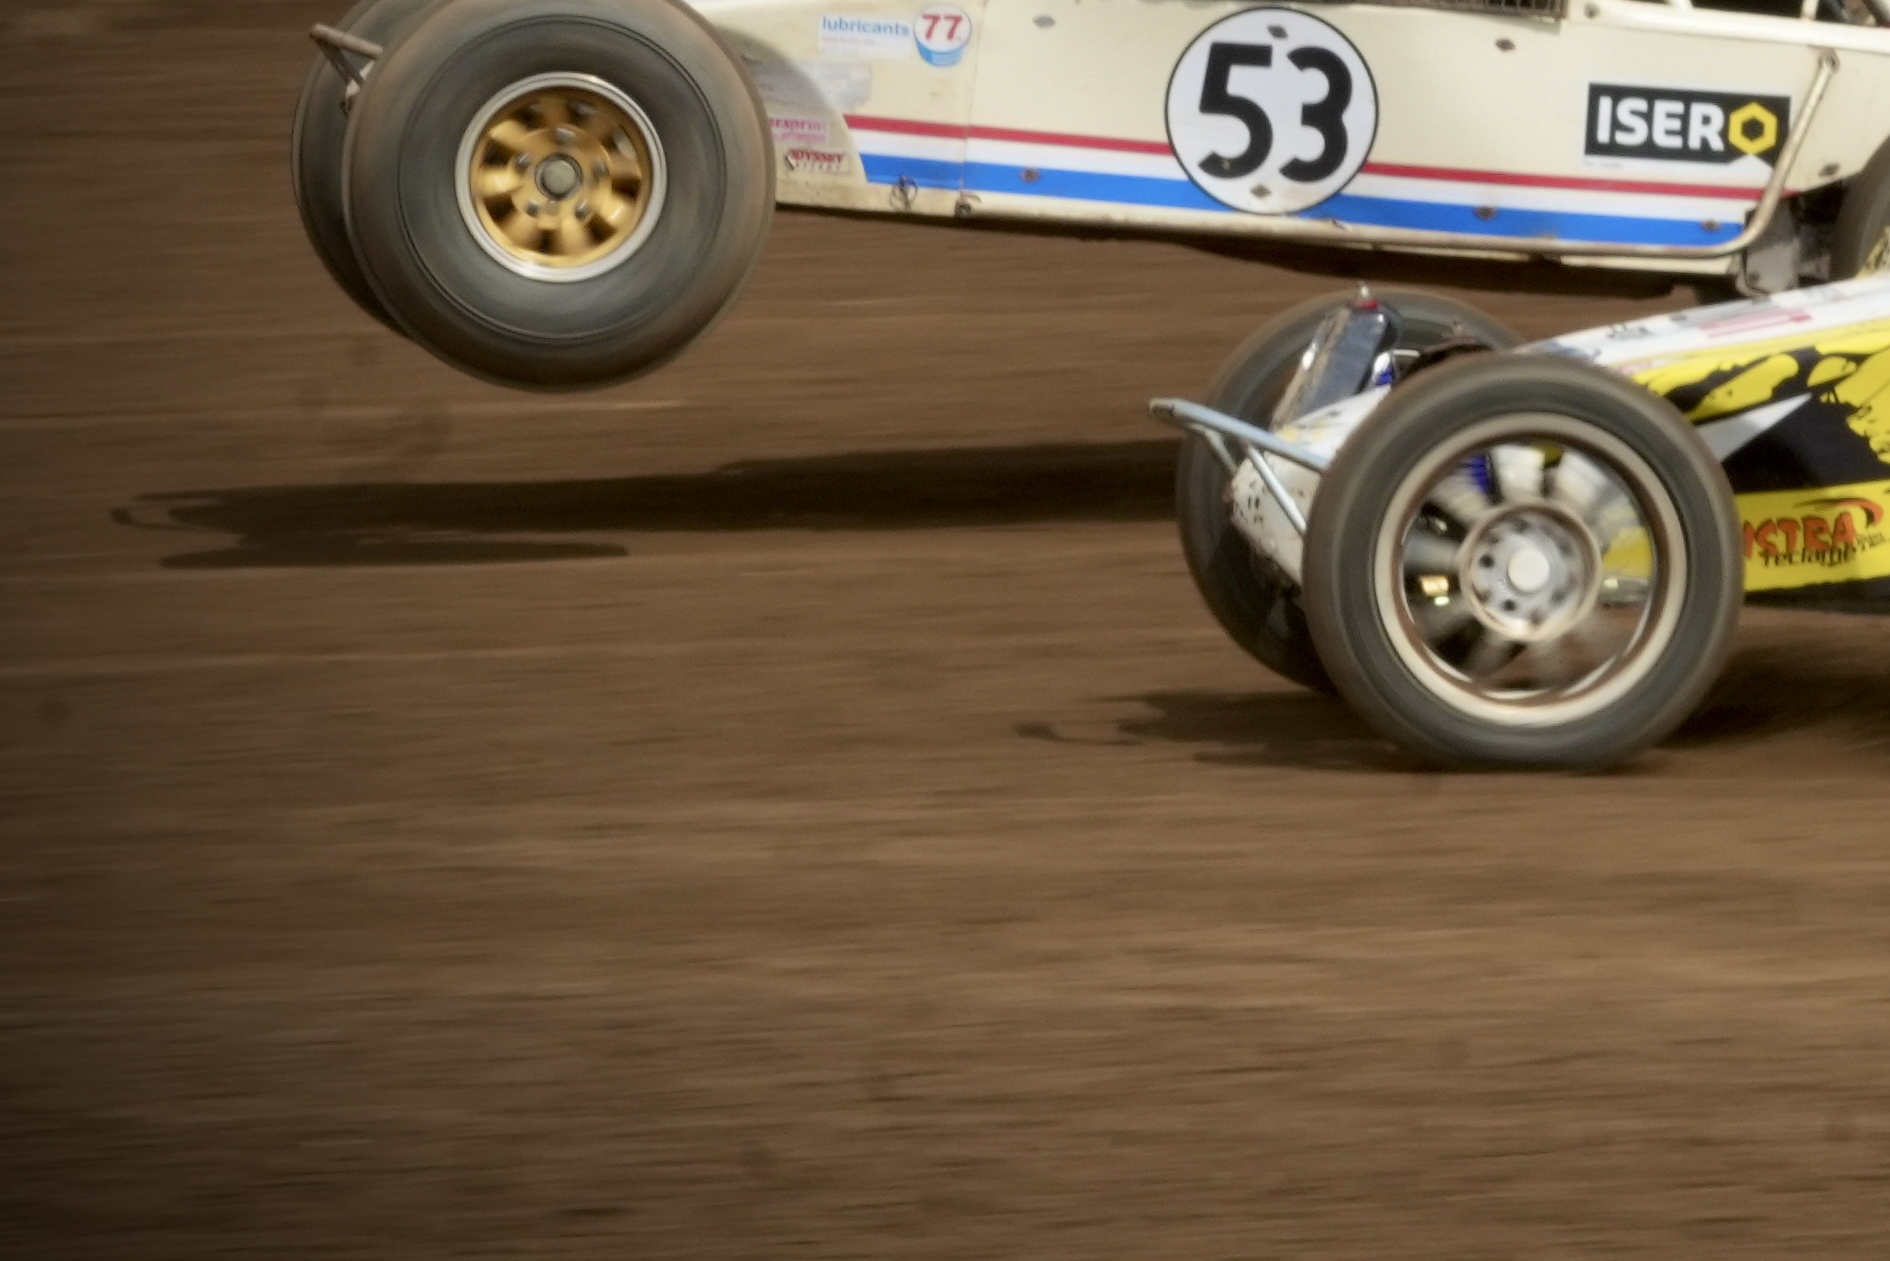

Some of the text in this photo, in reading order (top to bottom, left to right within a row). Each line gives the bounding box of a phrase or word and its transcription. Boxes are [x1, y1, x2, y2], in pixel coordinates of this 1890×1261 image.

[822, 12, 964, 42] lubricants 77
[1197, 41, 1354, 184] 53
[1596, 94, 1779, 156] ISERO
